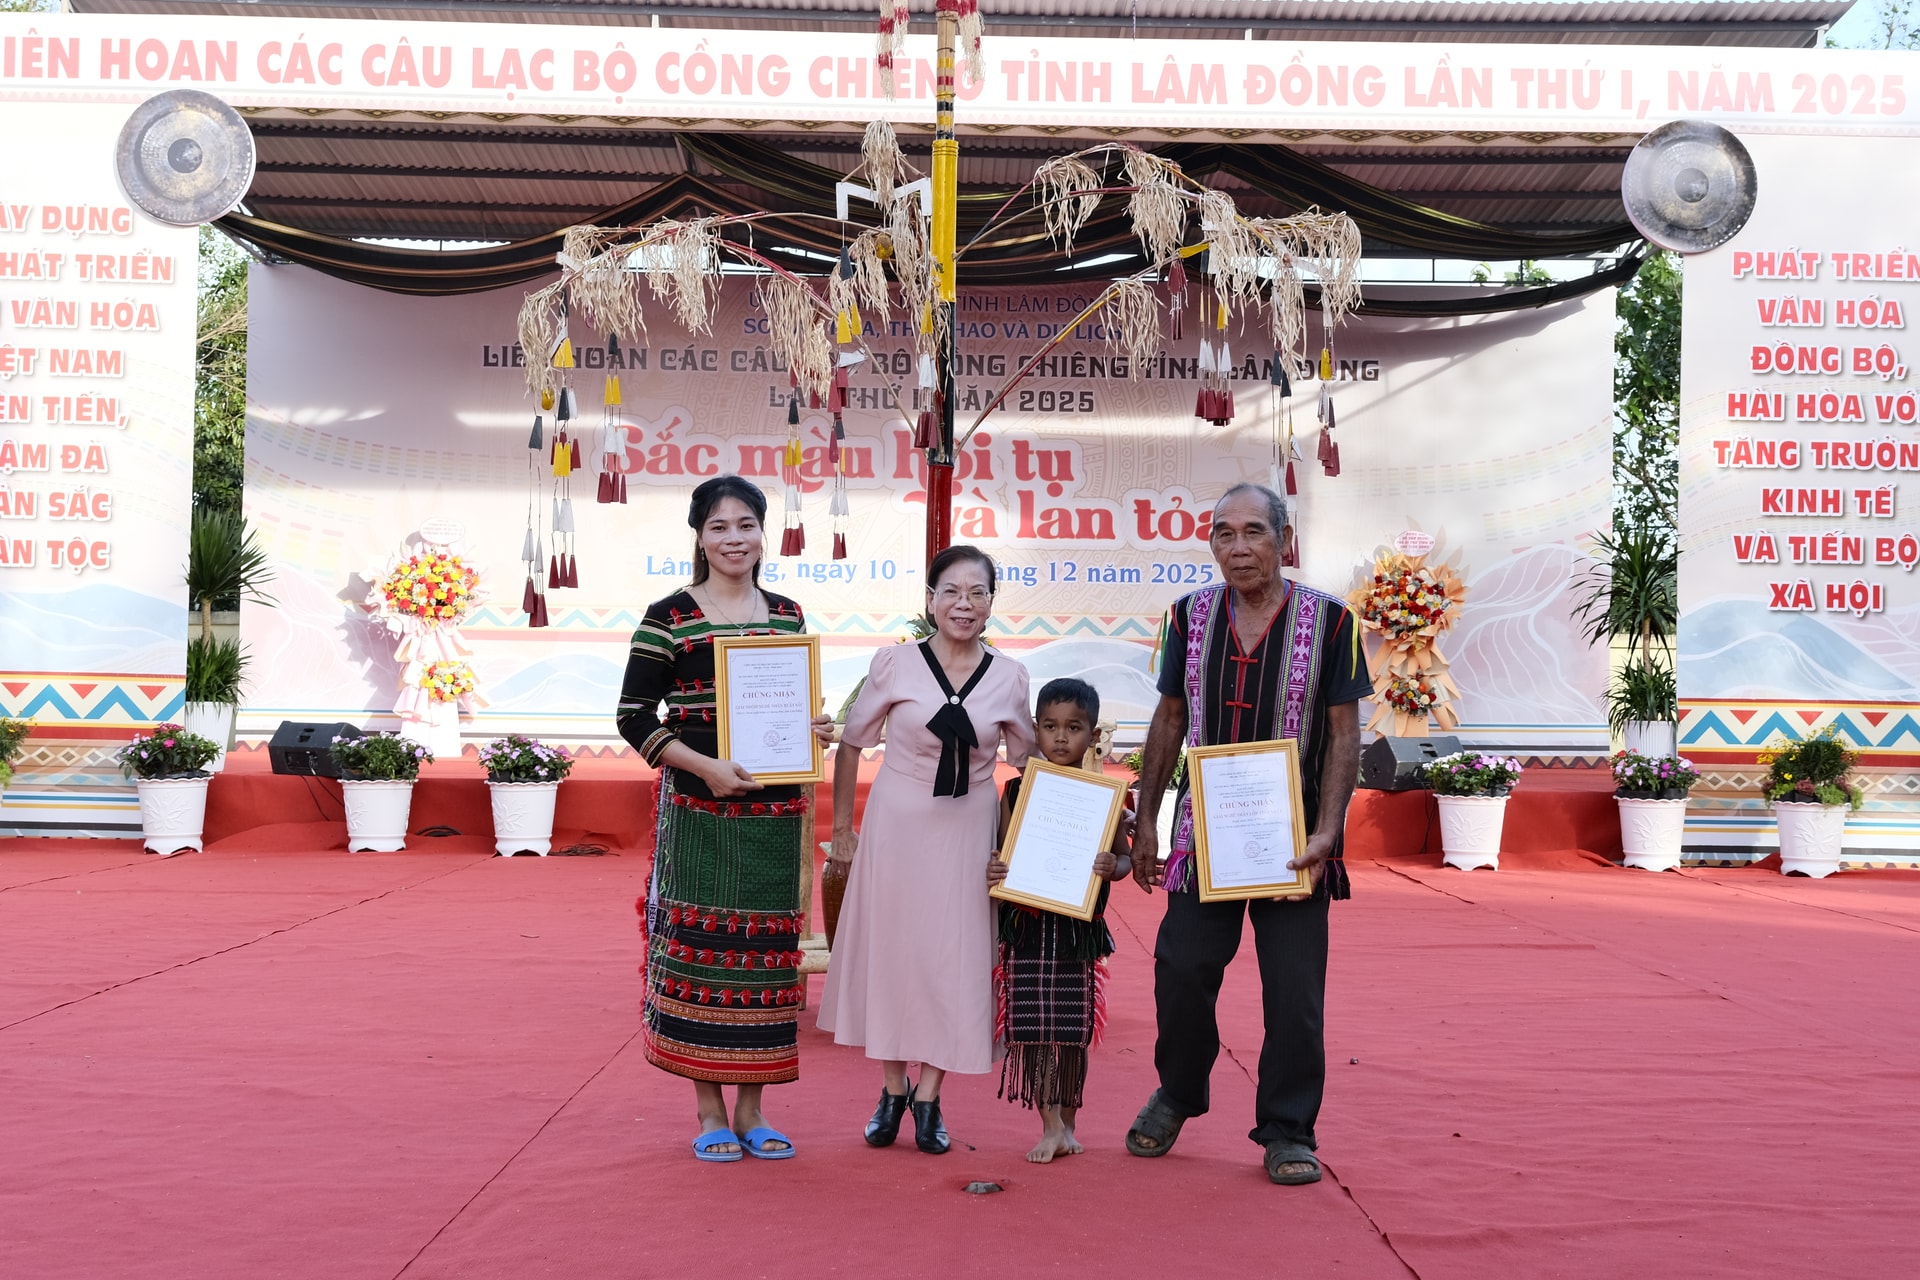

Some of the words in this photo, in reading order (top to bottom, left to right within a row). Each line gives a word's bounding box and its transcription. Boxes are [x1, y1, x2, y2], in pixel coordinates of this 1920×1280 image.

[100, 38, 238, 82] HOAN
[257, 33, 343, 86] CÁC
[361, 36, 452, 88] CÂU
[472, 47, 554, 101] LẠC
[573, 41, 637, 104] BỘ
[655, 38, 791, 97] CỒNG
[1001, 47, 1112, 103] TỈNH
[1131, 54, 1228, 104] LÂM
[1243, 51, 1386, 107] ĐỒNG
[1404, 53, 1493, 108] LẦN
[1511, 60, 1605, 110] THỨ
[1621, 70, 1650, 120] I,
[1668, 65, 1775, 112] NĂM
[1792, 73, 1906, 115] 2025
[42, 205, 130, 236] DỰNG
[75, 249, 172, 281] TRIỂN
[1733, 247, 1819, 276] PHÁT
[11, 297, 76, 326] VĂN
[90, 297, 157, 328] HÓA
[956, 291, 998, 311] ỈNH
[1007, 295, 1049, 312] LÂM
[1757, 296, 1822, 324] VĂN
[1836, 295, 1901, 326] HÓA
[956, 322, 996, 338] HAO
[1002, 319, 1030, 338] VÀ
[49, 348, 121, 376] NAM
[482, 341, 528, 368] LIÊ
[660, 344, 719, 372] CÁC
[1750, 340, 1839, 372] ĐỒNG
[1853, 344, 1908, 378] BỘ,
[42, 391, 129, 428] TIẾN,
[1019, 390, 1094, 413] 2025
[1728, 389, 1782, 418] HÀI
[1796, 389, 1862, 419] HÒA
[1875, 391, 1920, 421] VỚ
[60, 440, 105, 470] ĐÀ
[1713, 437, 1798, 466] TĂNG
[1012, 440, 1075, 497] tụ
[48, 486, 112, 520] SẮC
[1017, 490, 1116, 540] lan
[1762, 488, 1841, 514] KINH
[1854, 484, 1896, 515] TẾ
[46, 536, 108, 572] TỘC
[1733, 531, 1776, 560] VÀ
[1788, 530, 1861, 561] TIẾN
[1875, 534, 1918, 568] BỘ
[797, 559, 857, 583] ngày
[870, 560, 896, 580] 10
[1050, 562, 1077, 582] 12
[1087, 565, 1141, 583] năm
[1151, 563, 1213, 584] 2025
[1770, 579, 1813, 608] XÃ
[1826, 580, 1881, 615] HỘI
